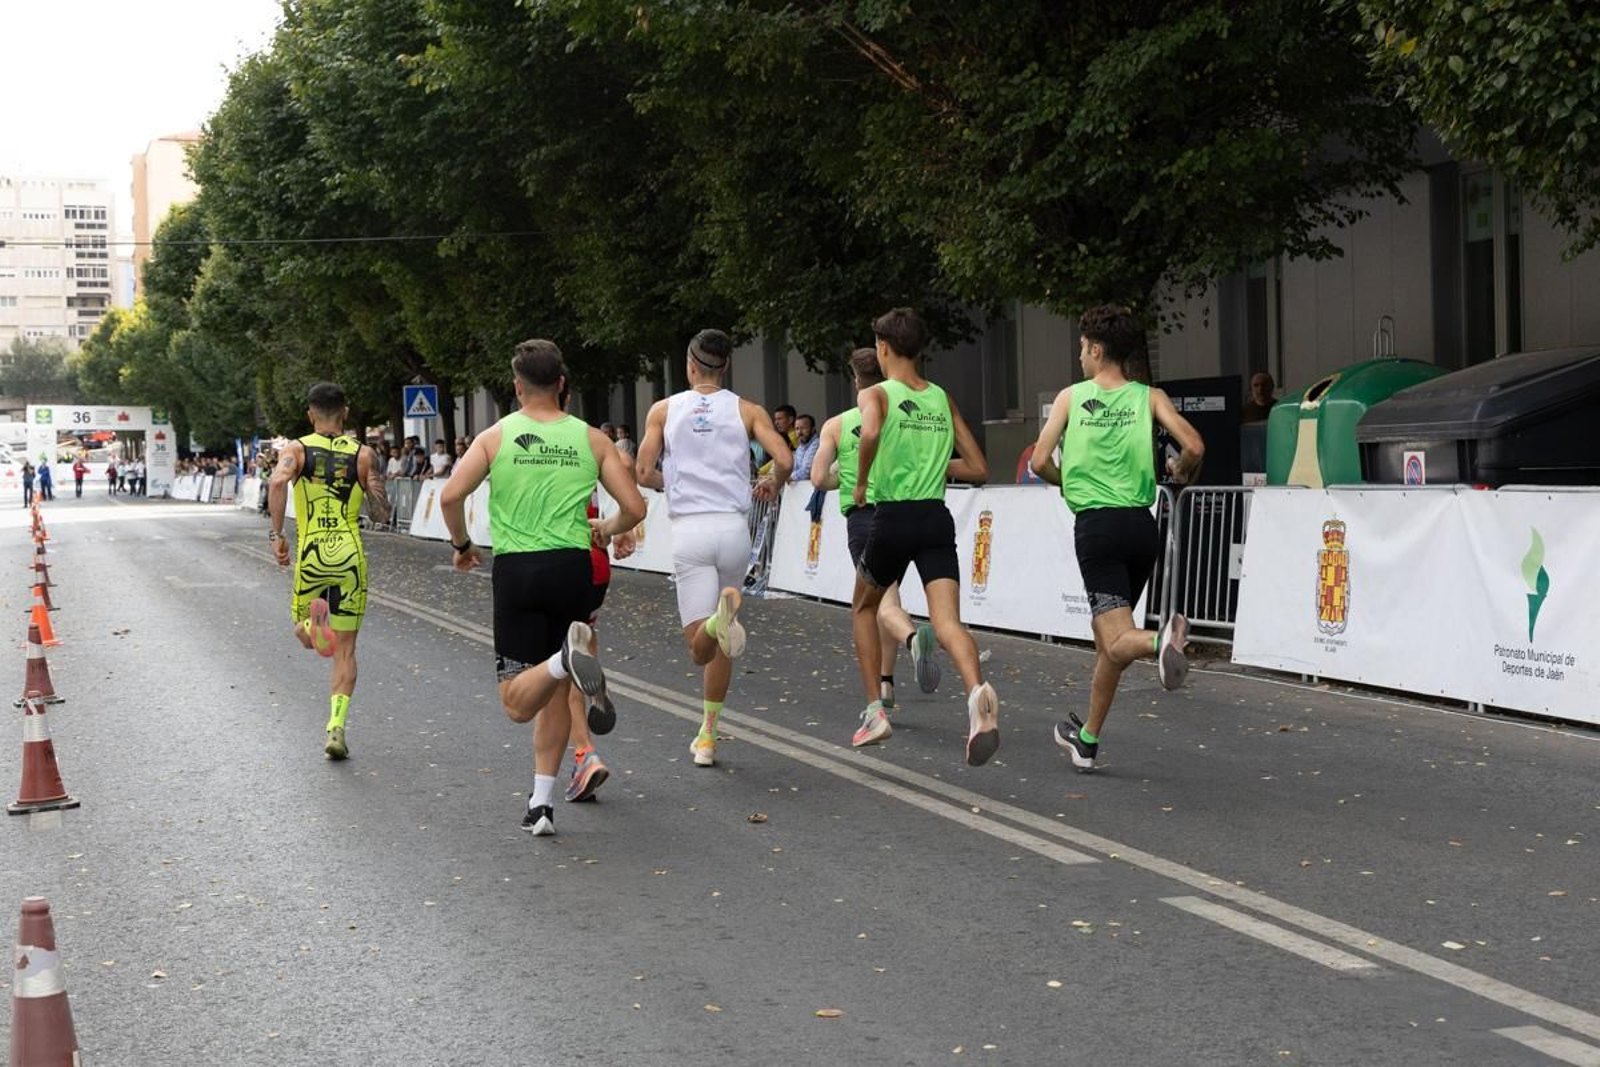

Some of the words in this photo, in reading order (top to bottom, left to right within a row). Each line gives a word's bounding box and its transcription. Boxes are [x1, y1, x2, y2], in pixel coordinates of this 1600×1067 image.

[72, 411, 91, 424] 36
[917, 412, 947, 424] Unicaja
[539, 444, 578, 458] Unicaja
[513, 457, 558, 465] Fundación
[560, 458, 580, 467] Jaén
[317, 517, 338, 528] 1153
[1494, 644, 1526, 660] Patronato
[1527, 648, 1564, 666] Municipal
[1564, 654, 1575, 666] de
[1502, 661, 1533, 677] Deportes
[1534, 666, 1545, 678] de
[1546, 668, 1565, 681] Jaén
